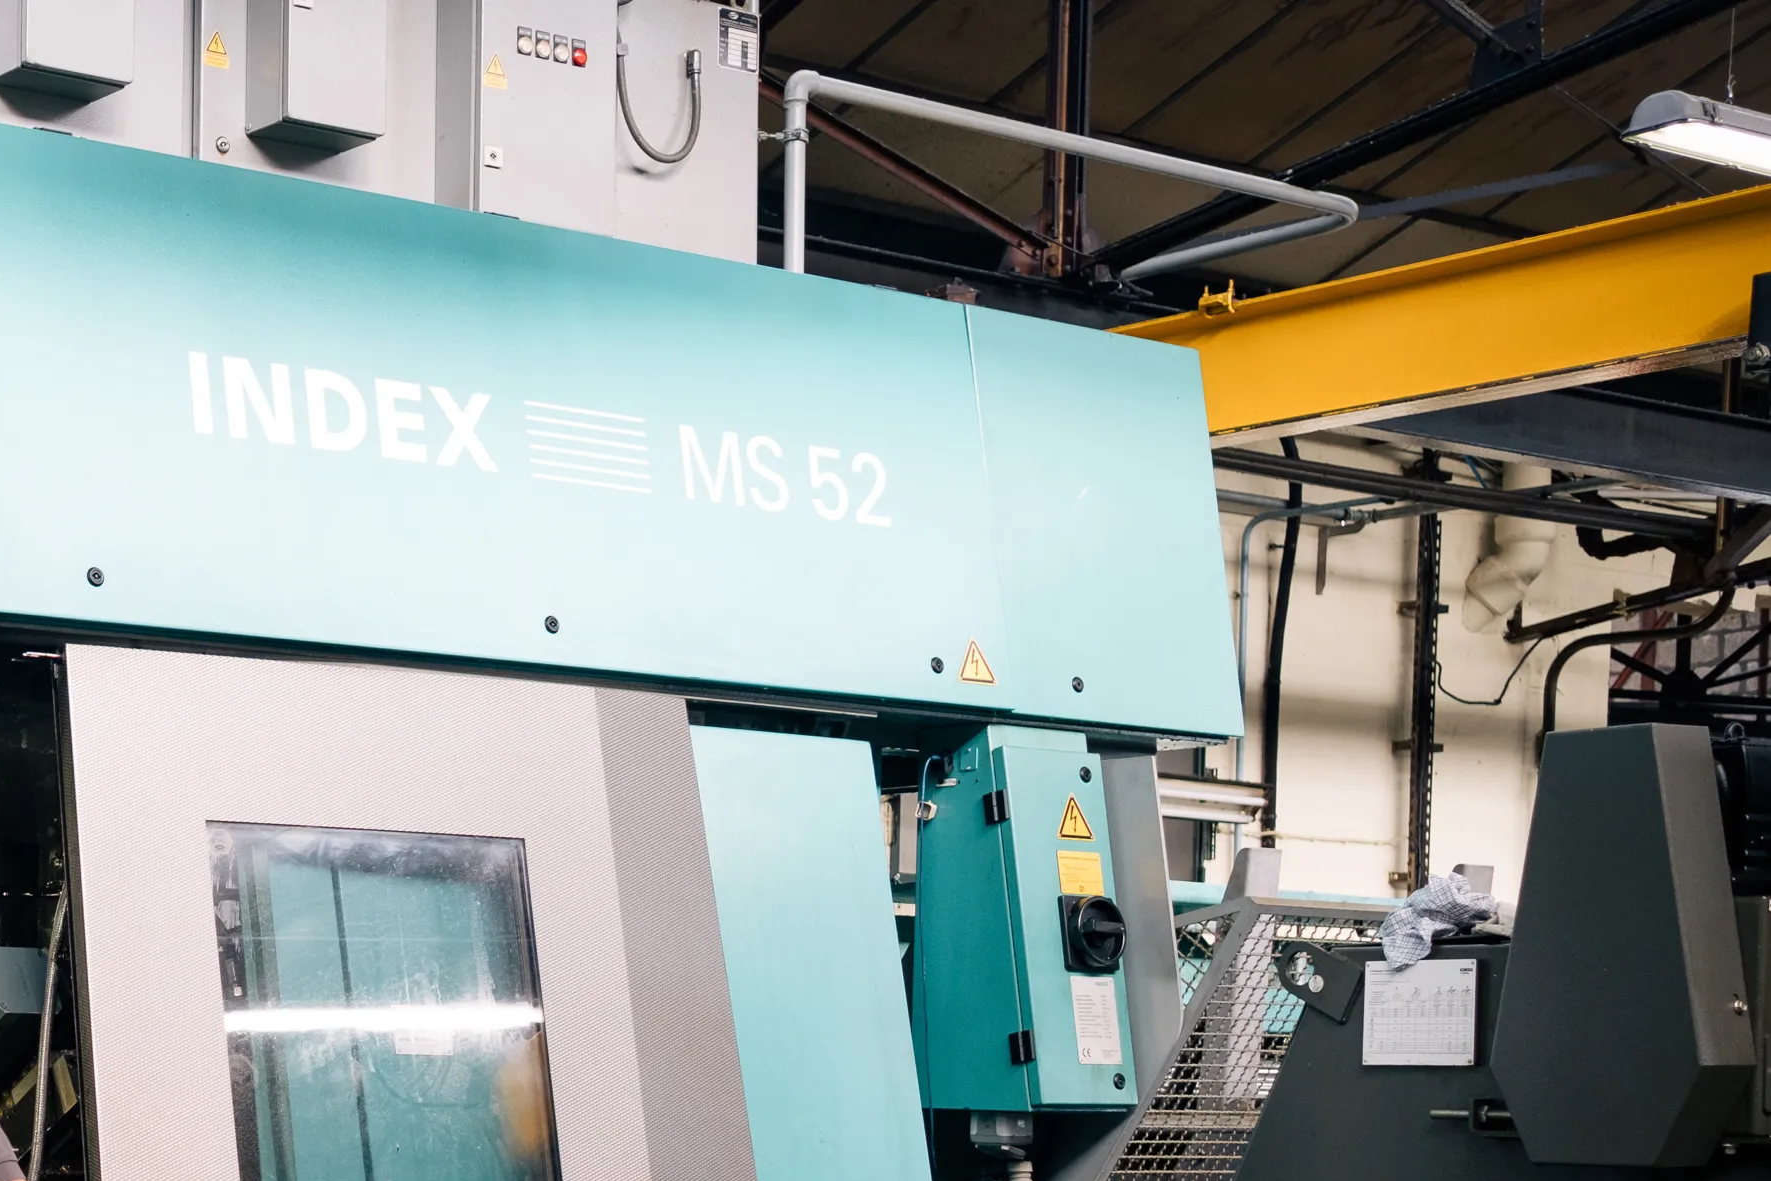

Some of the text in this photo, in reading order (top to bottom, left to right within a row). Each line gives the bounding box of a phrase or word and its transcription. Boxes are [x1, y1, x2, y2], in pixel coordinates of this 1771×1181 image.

[187, 350, 893, 528] INDEX MS 52
